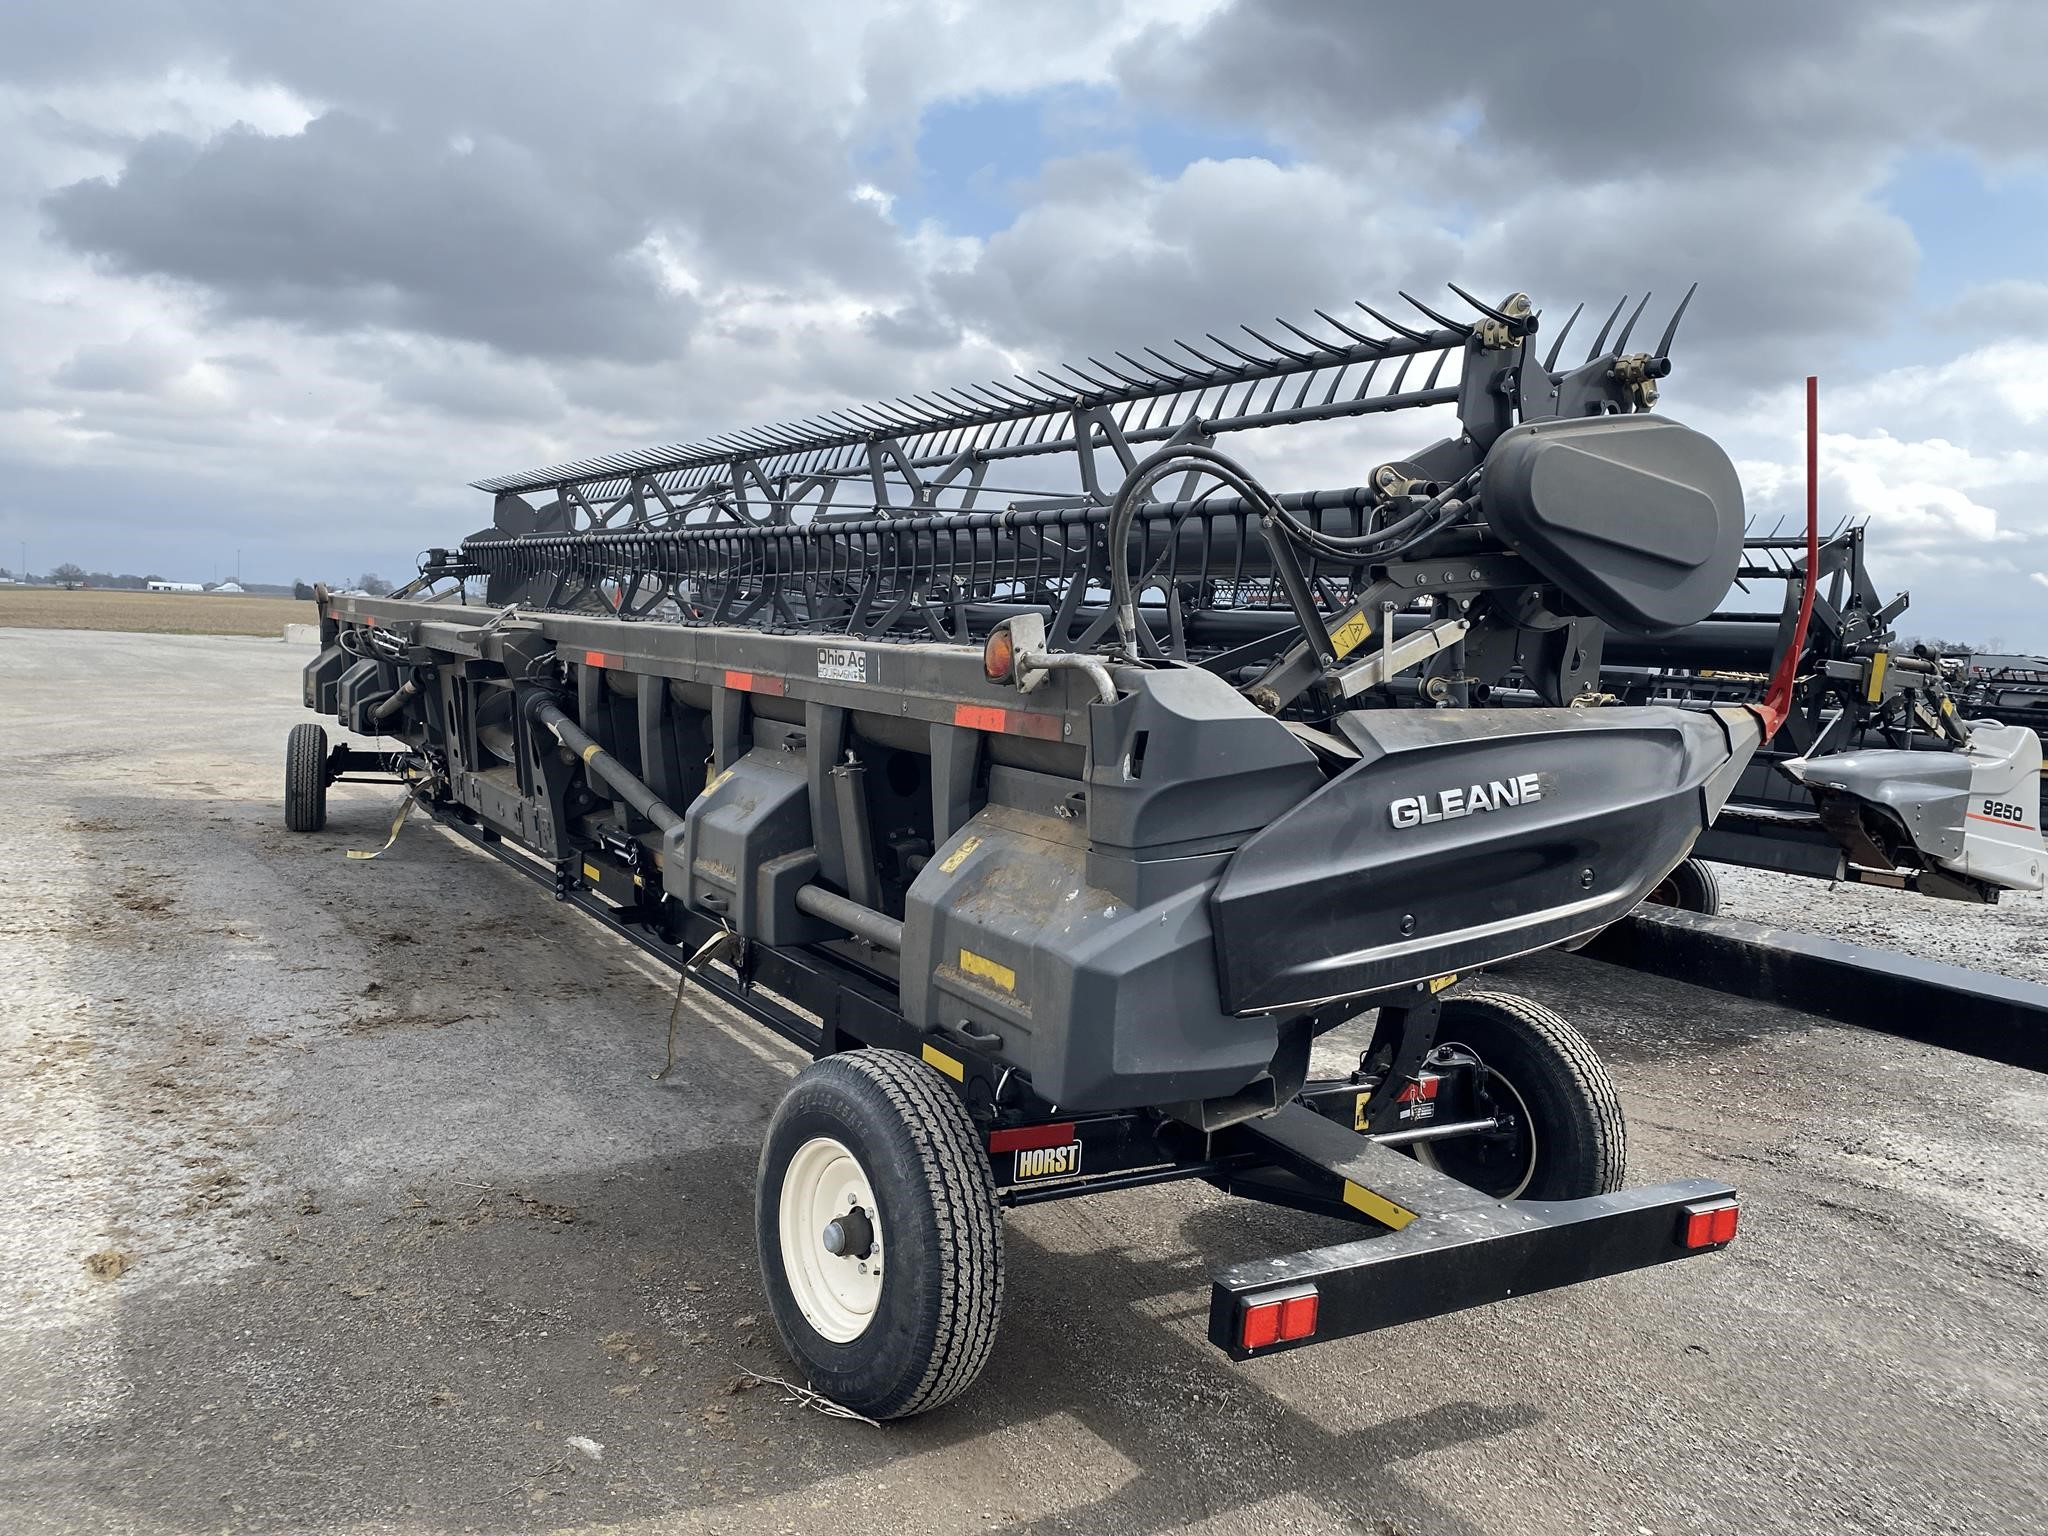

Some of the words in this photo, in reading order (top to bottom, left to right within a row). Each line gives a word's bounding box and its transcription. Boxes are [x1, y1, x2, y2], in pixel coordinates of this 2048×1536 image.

[818, 649, 845, 666] Ohio
[848, 651, 865, 672] Ag
[1389, 773, 1541, 829] GLEANE
[1983, 799, 2023, 821] 9250
[1019, 1144, 1079, 1178] HORST
